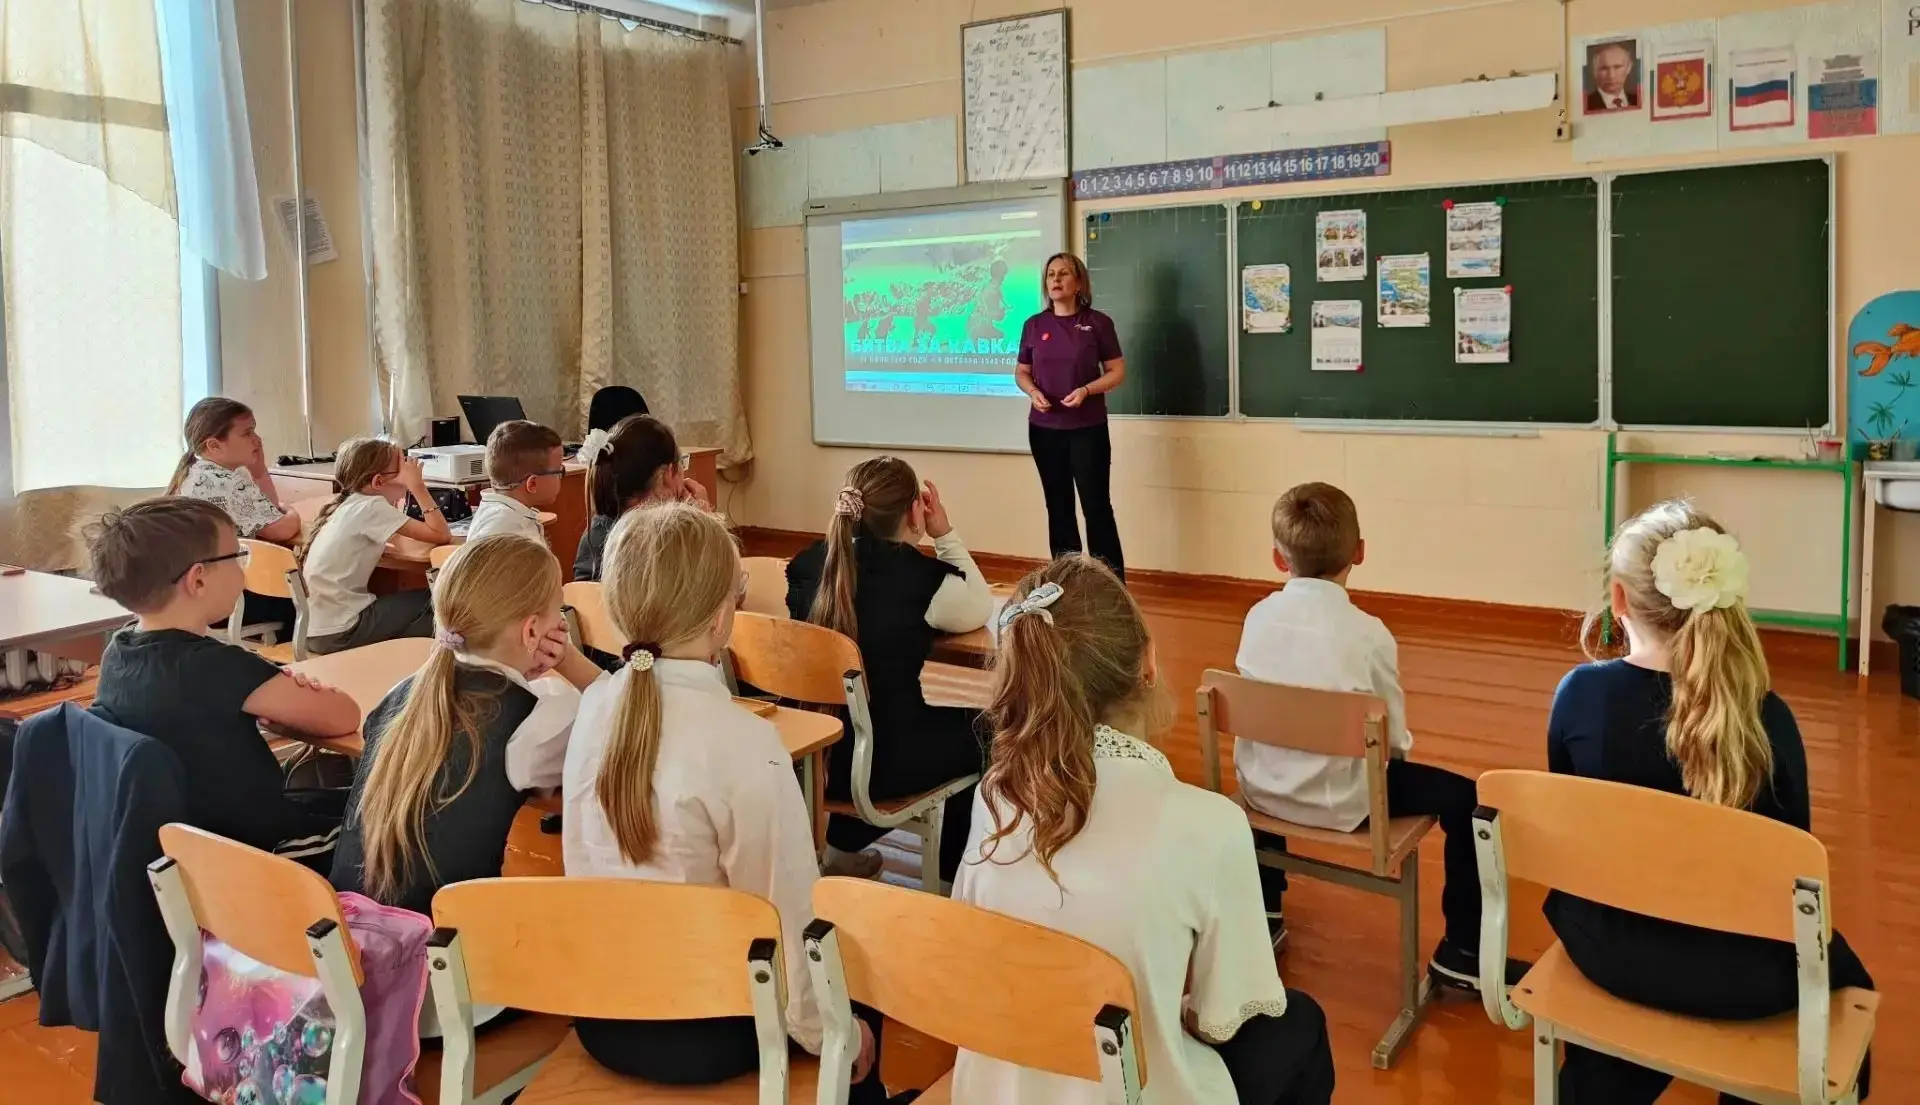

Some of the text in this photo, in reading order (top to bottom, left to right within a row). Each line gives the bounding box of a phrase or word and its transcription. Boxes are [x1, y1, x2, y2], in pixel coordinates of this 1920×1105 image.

[1080, 152, 1379, 192] 0 1 2 3 4 5 6 7 8 9 10 11 12 13 14 15 16 17 18 19 20
[947, 338, 1020, 354] КАВКА
